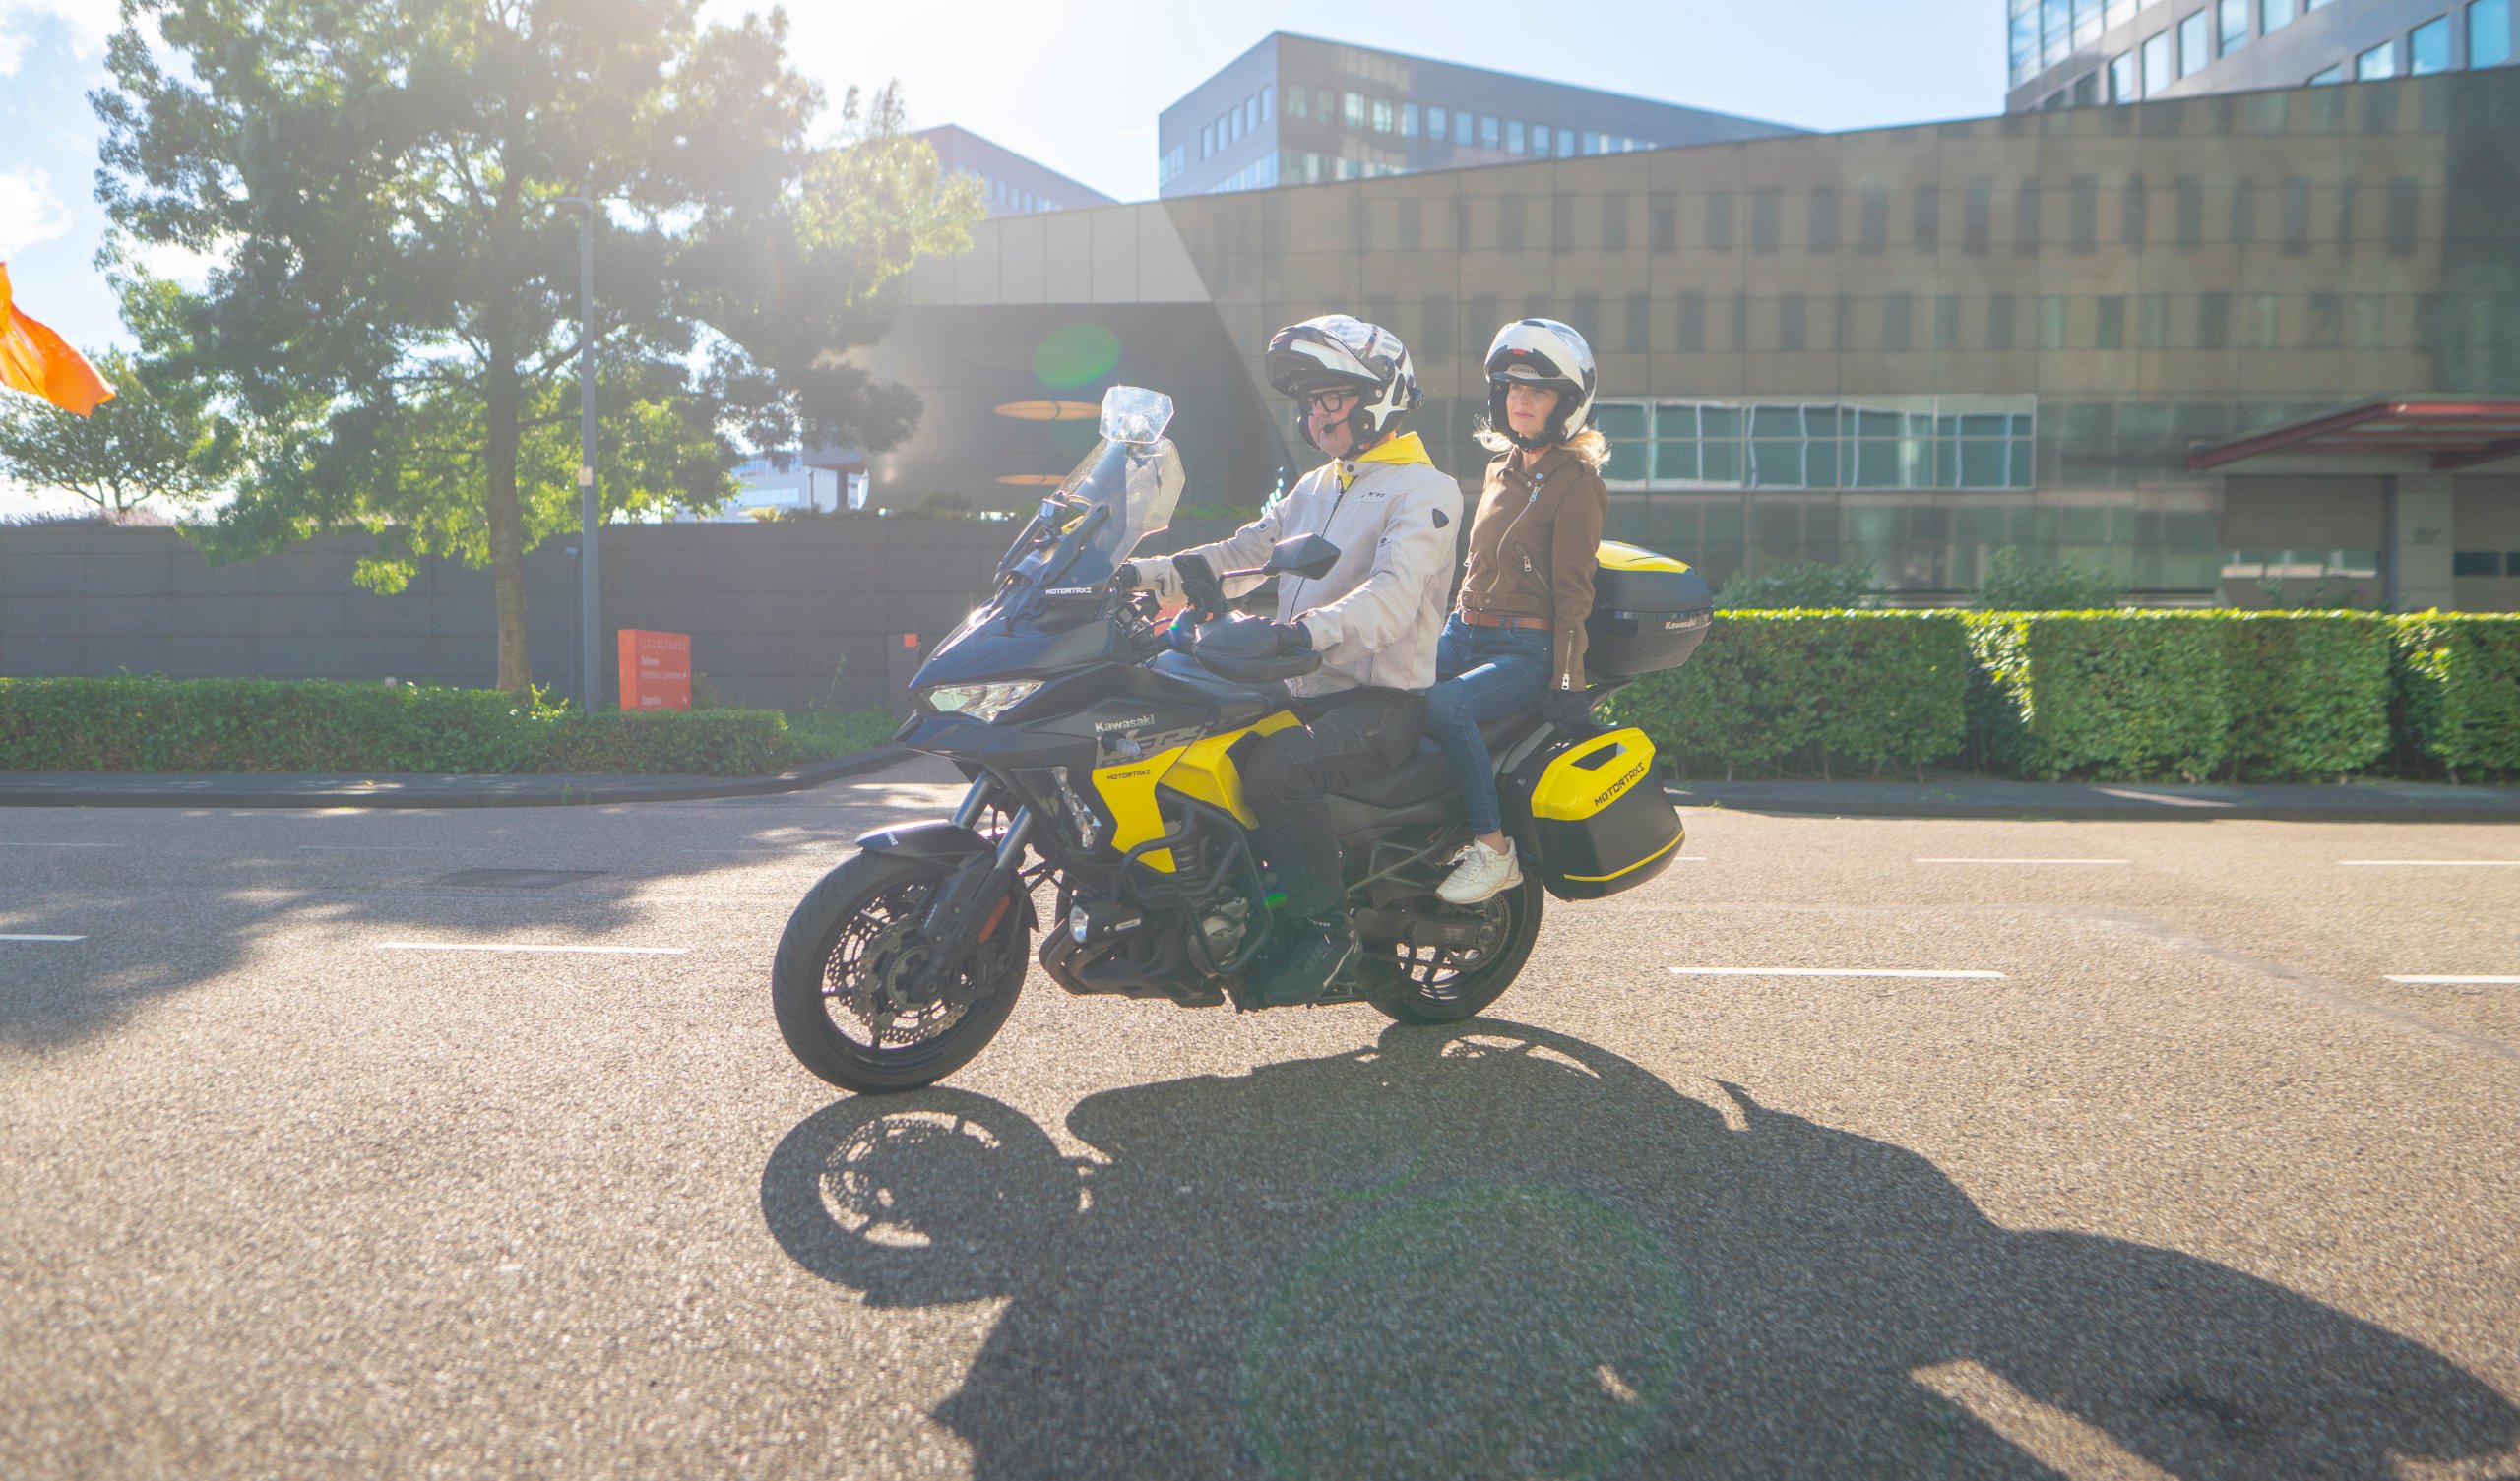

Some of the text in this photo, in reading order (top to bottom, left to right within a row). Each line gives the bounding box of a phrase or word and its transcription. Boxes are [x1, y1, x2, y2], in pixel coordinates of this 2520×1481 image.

[1095, 714, 1155, 732] Kawasaki
[1107, 770, 1150, 780] MOTORTAXI
[1593, 761, 1645, 807] MOTORTAXI
